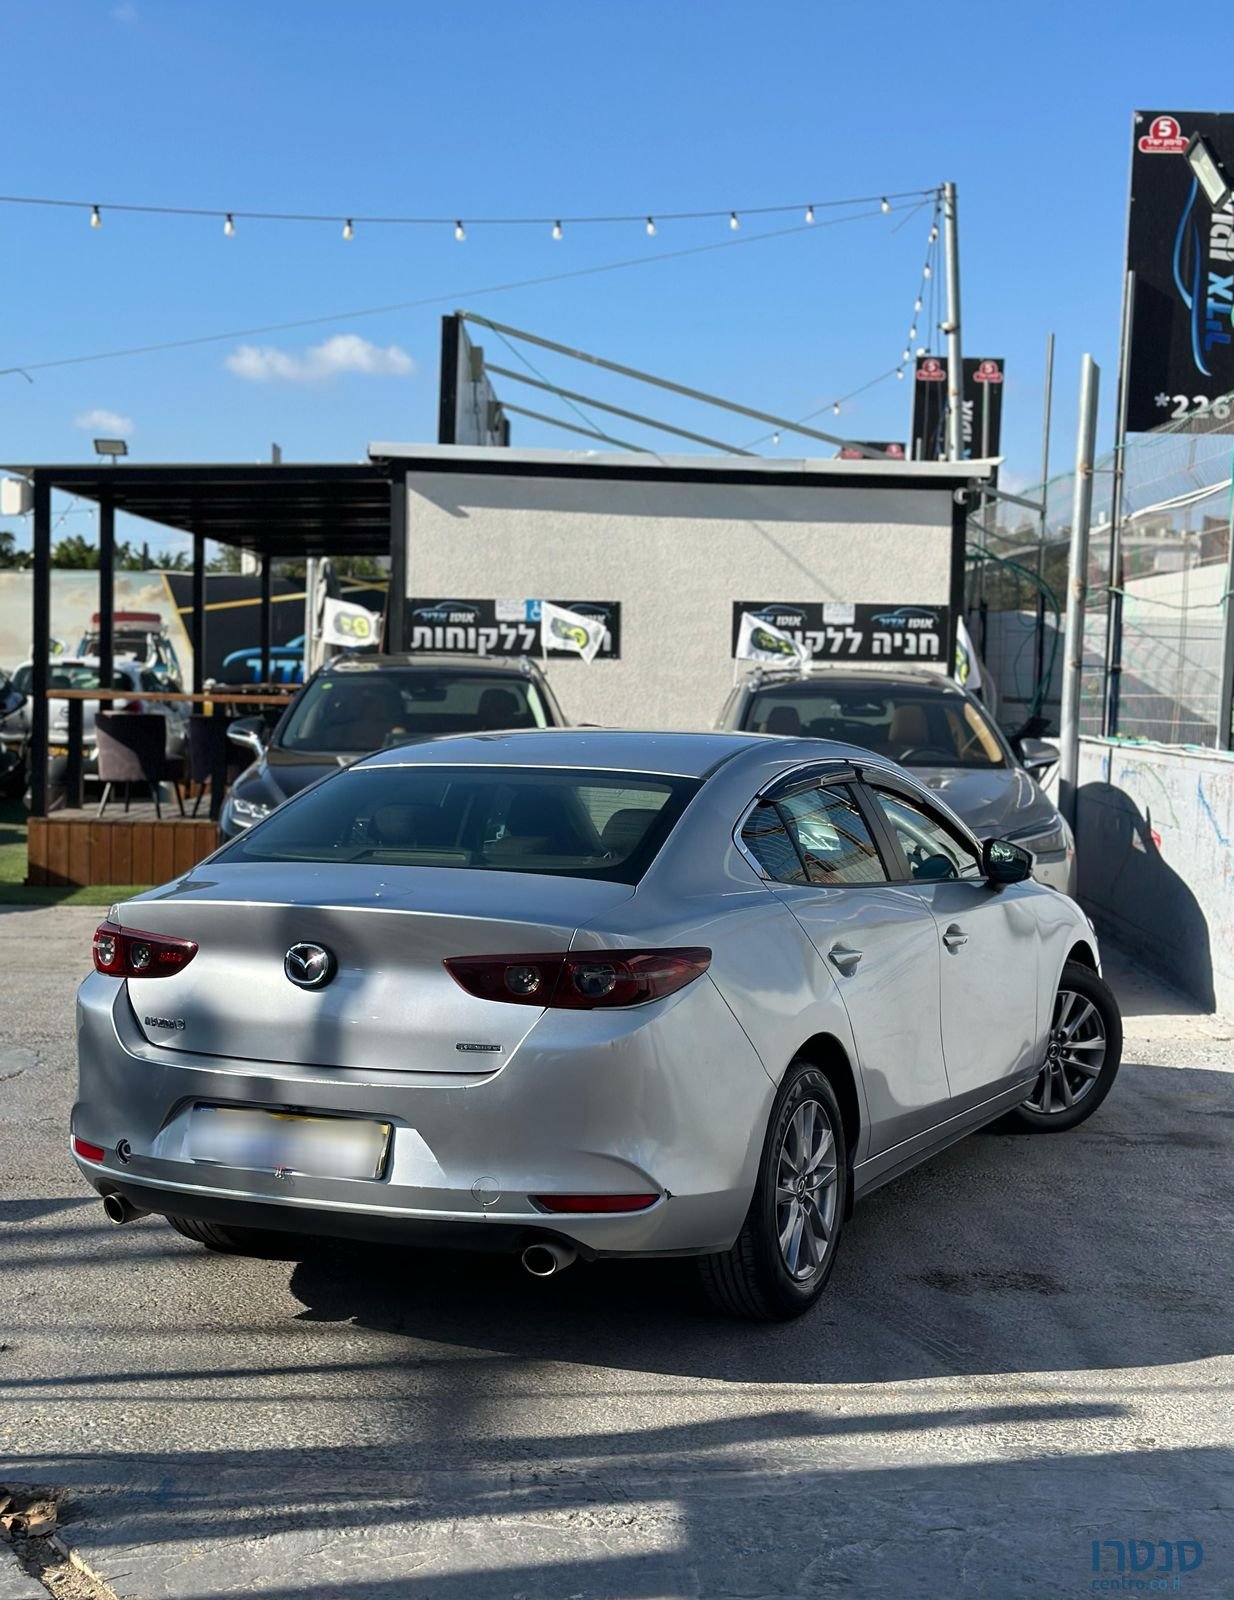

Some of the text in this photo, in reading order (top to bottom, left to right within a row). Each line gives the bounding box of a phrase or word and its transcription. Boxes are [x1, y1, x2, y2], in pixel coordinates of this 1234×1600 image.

[1158, 120, 1172, 137] 5
[1204, 271, 1234, 352] אדיר
[449, 612, 475, 623] אוטו
[776, 615, 802, 627] אוטו
[907, 618, 934, 629] אוטו
[410, 624, 536, 656] ללקוחות
[872, 632, 940, 656] חניה
